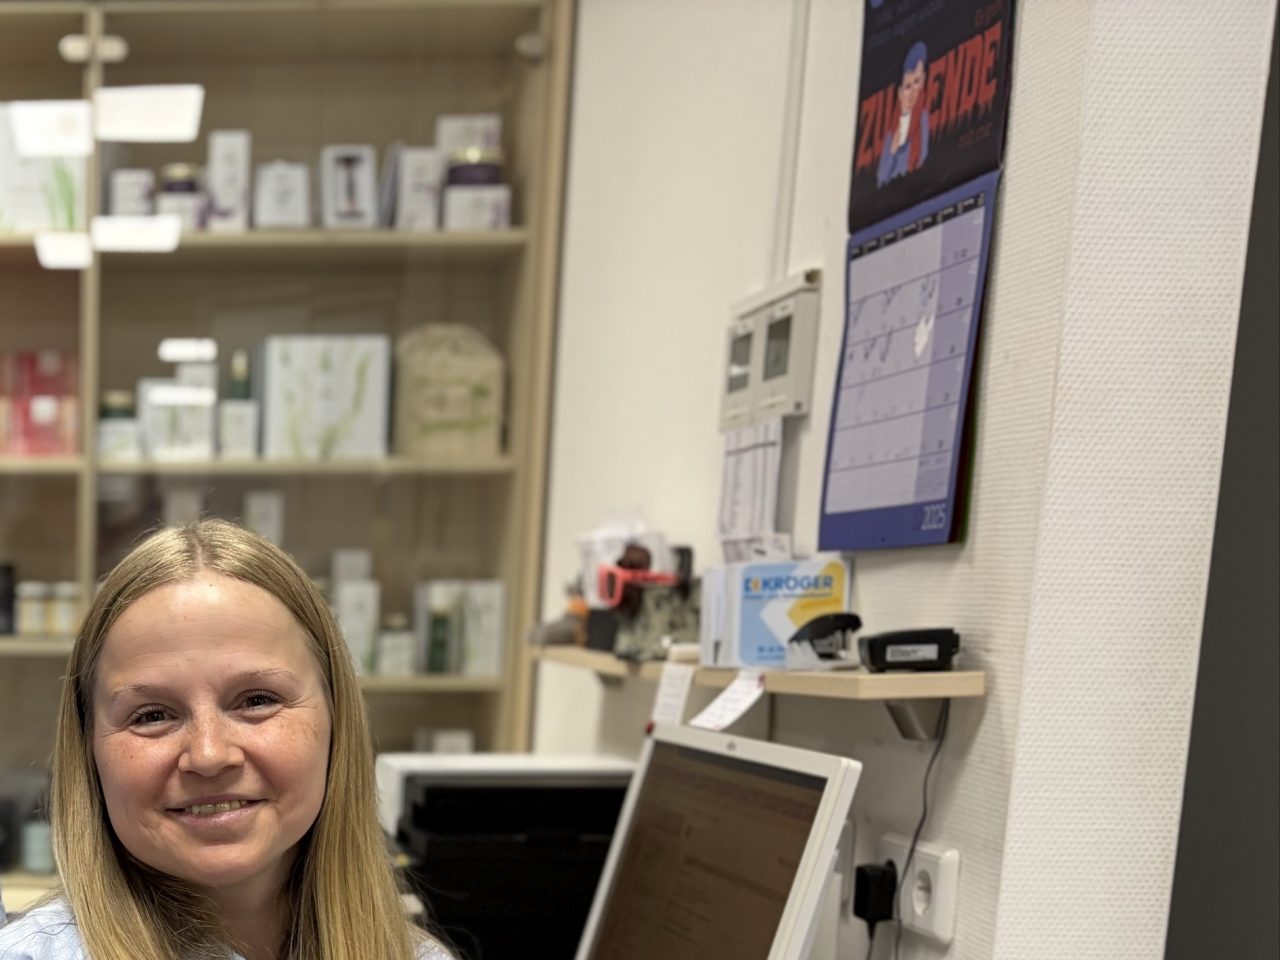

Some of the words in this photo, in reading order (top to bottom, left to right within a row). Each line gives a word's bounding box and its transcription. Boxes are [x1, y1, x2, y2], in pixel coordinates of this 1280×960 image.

[927, 20, 1002, 136] ENDE
[922, 504, 945, 530] 2025
[763, 575, 833, 591] KRÖGER
